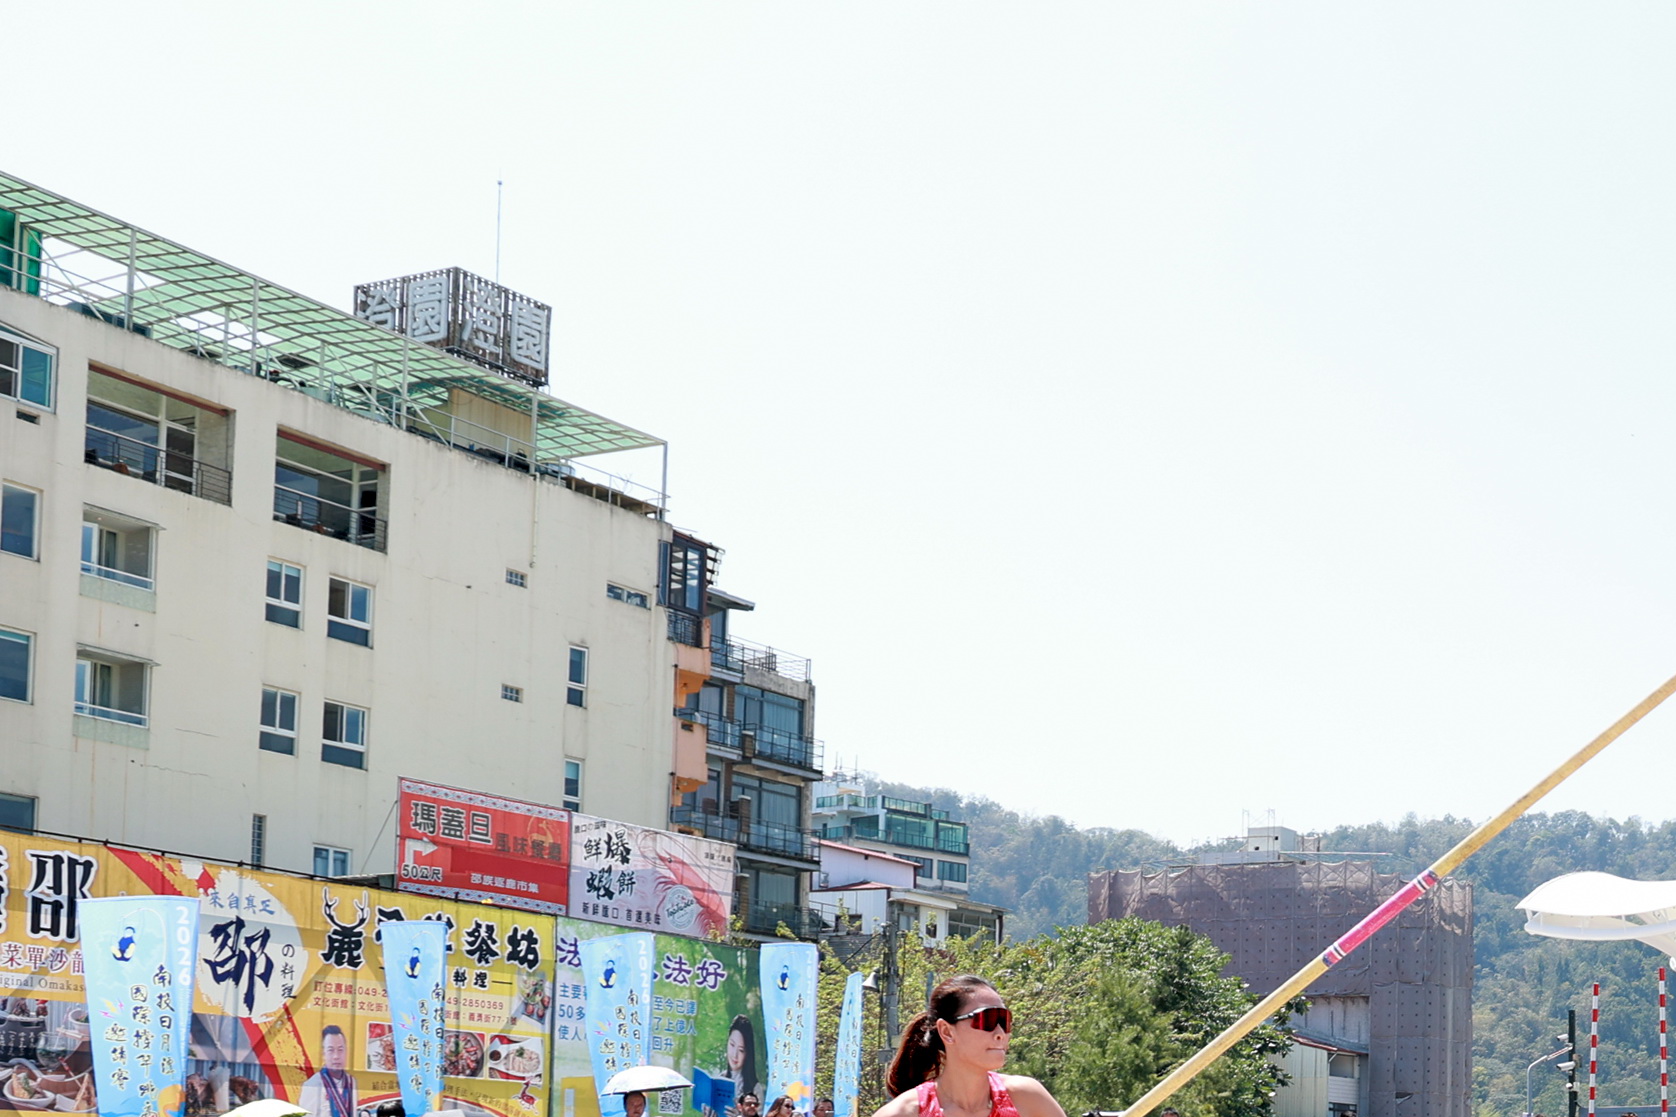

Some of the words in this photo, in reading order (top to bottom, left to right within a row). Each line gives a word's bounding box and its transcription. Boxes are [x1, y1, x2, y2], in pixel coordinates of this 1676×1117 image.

[410, 801, 493, 844] 瑪蓋旦
[496, 832, 562, 862] 風味餐廳
[402, 864, 443, 882] 50公尺
[470, 873, 540, 893] 邵族逐鹿市集
[175, 906, 192, 986] 2026
[319, 886, 541, 973] 鹿餐坊
[202, 914, 275, 1016] 邵
[279, 943, 297, 1000] の料理
[153, 965, 176, 1081] 南投日月潭
[627, 989, 643, 1066] 南投日月
